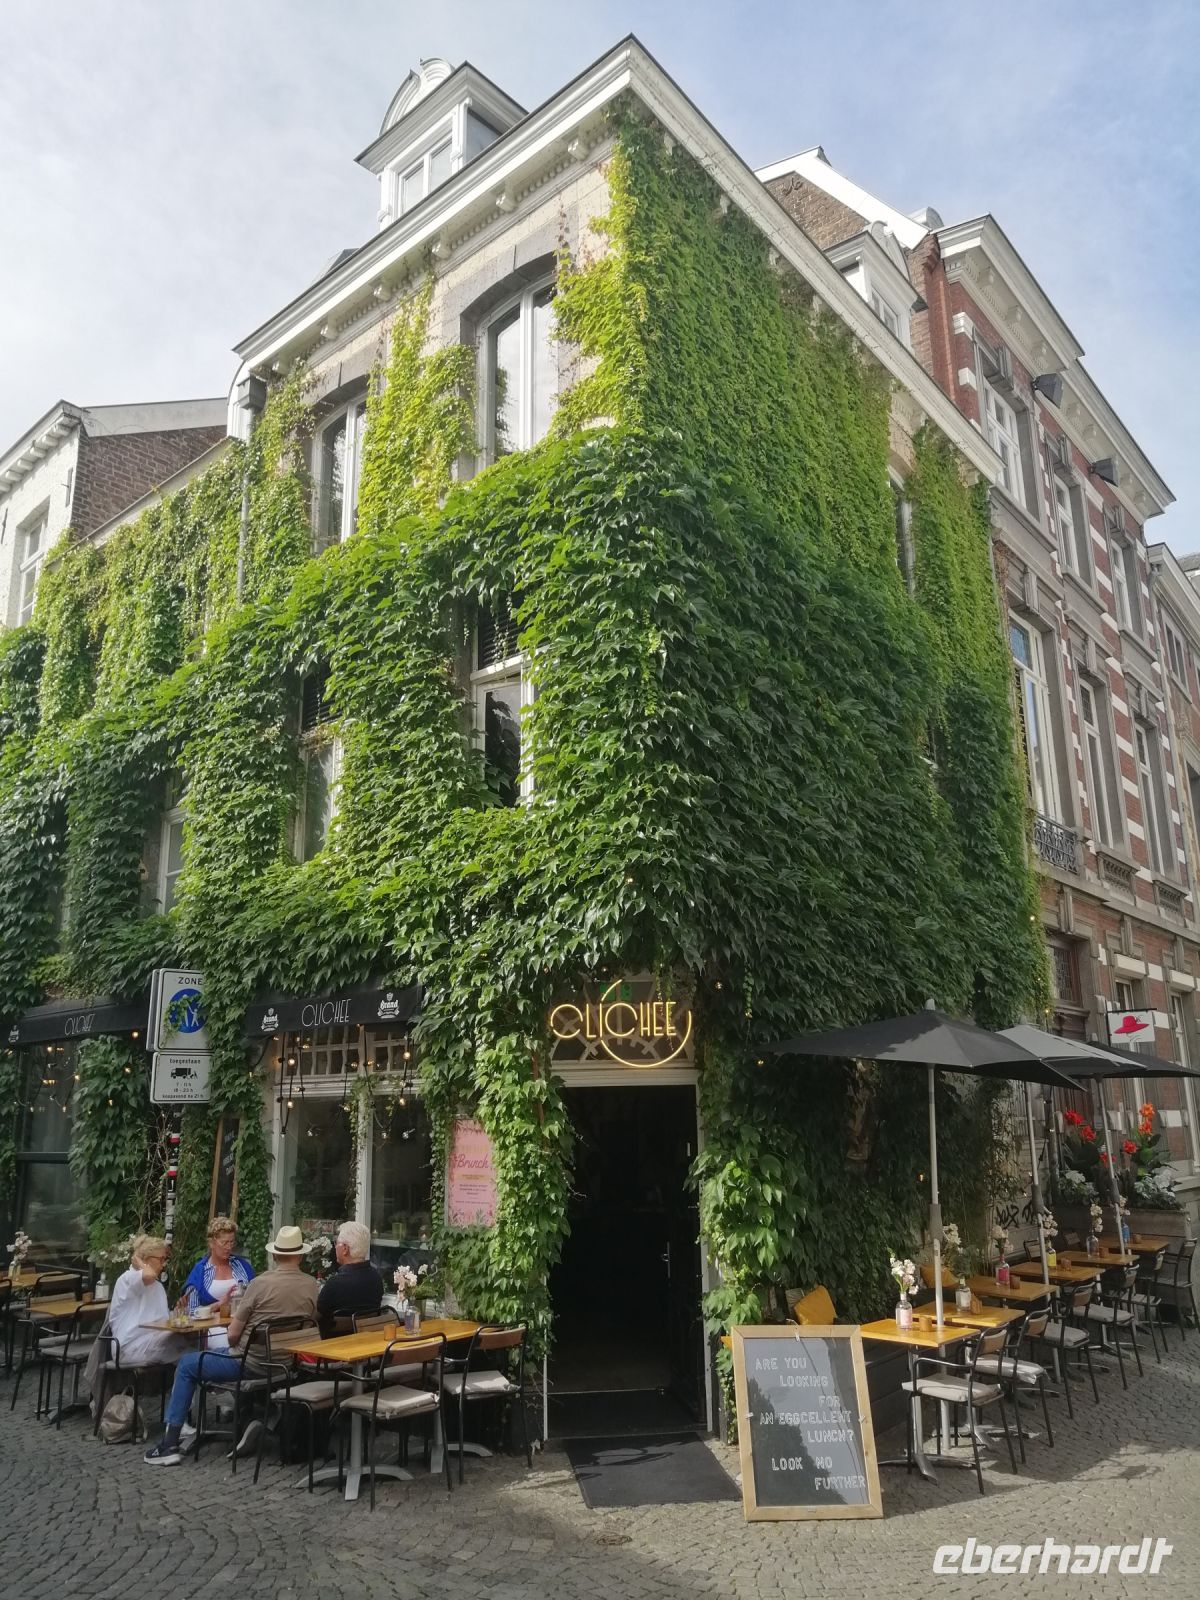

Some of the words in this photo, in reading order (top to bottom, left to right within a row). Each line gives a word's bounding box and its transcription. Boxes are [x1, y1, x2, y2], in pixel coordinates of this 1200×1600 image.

[178, 976, 204, 986] ZONE
[380, 999, 399, 1010] Brand
[301, 999, 351, 1027] CLICHEE
[550, 1001, 677, 1039] CLICHEE
[456, 1153, 489, 1168] Brunch
[755, 1358, 779, 1370] ARE
[784, 1357, 807, 1369] YOU
[779, 1375, 828, 1387] LOOKING
[818, 1395, 841, 1407] FOR
[759, 1412, 775, 1425] AN
[778, 1411, 852, 1424] EGGCELLENT
[807, 1430, 854, 1443] LUNCH?
[771, 1457, 804, 1471] LOOK
[815, 1456, 833, 1469] NO
[814, 1476, 866, 1490] FURTHER
